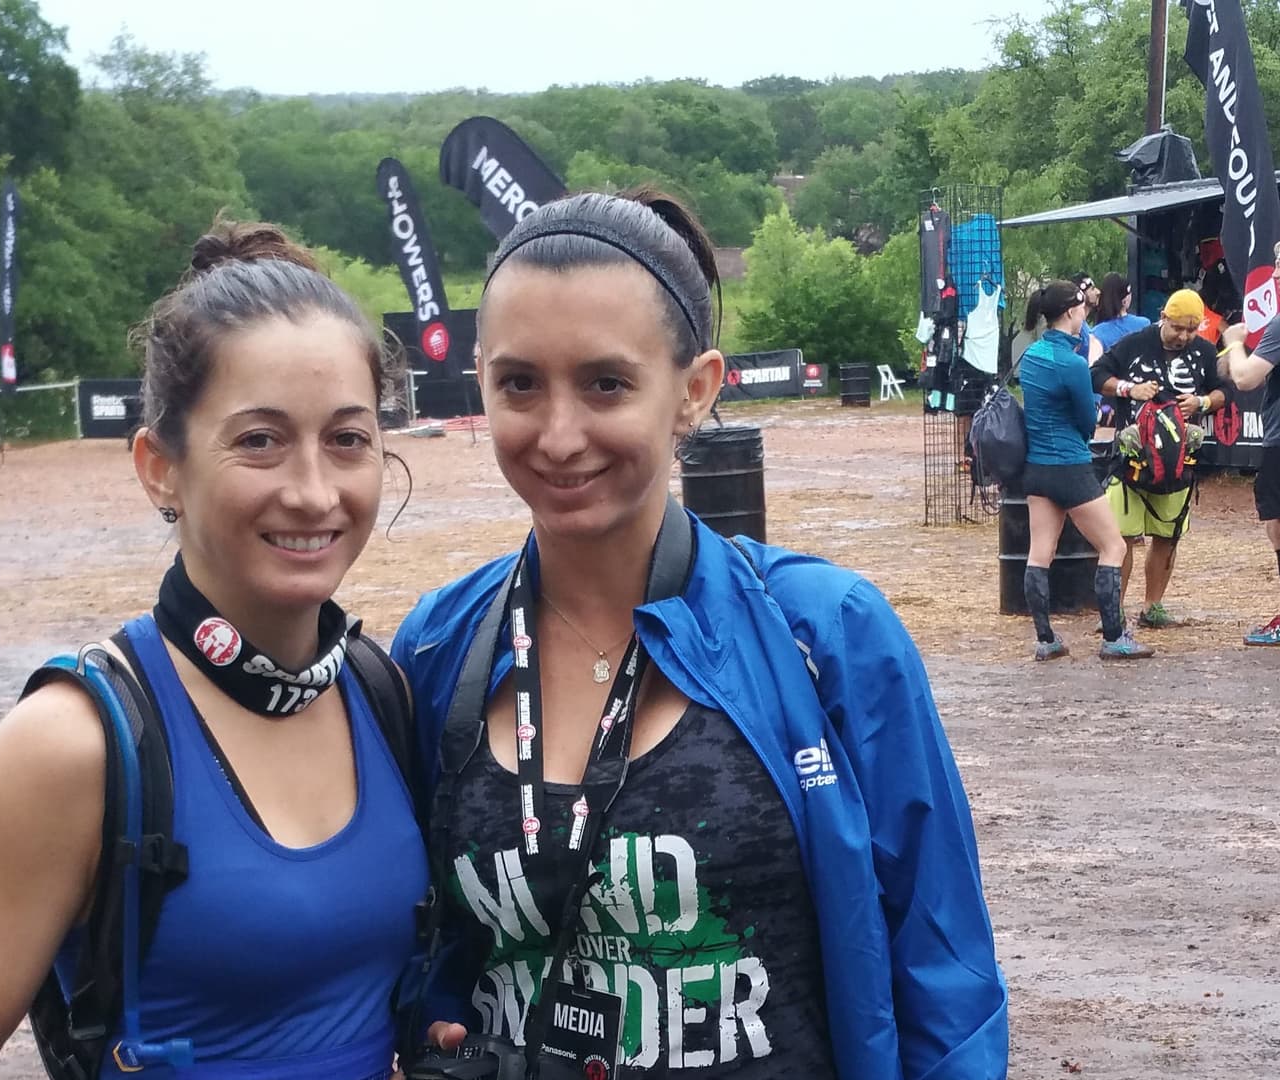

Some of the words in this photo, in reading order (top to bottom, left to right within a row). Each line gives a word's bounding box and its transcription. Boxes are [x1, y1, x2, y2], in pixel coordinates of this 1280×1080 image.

[472, 145, 540, 224] MERC
[453, 834, 699, 949] MND
[577, 935, 632, 963] OVER
[553, 1002, 606, 1039] MEDIA
